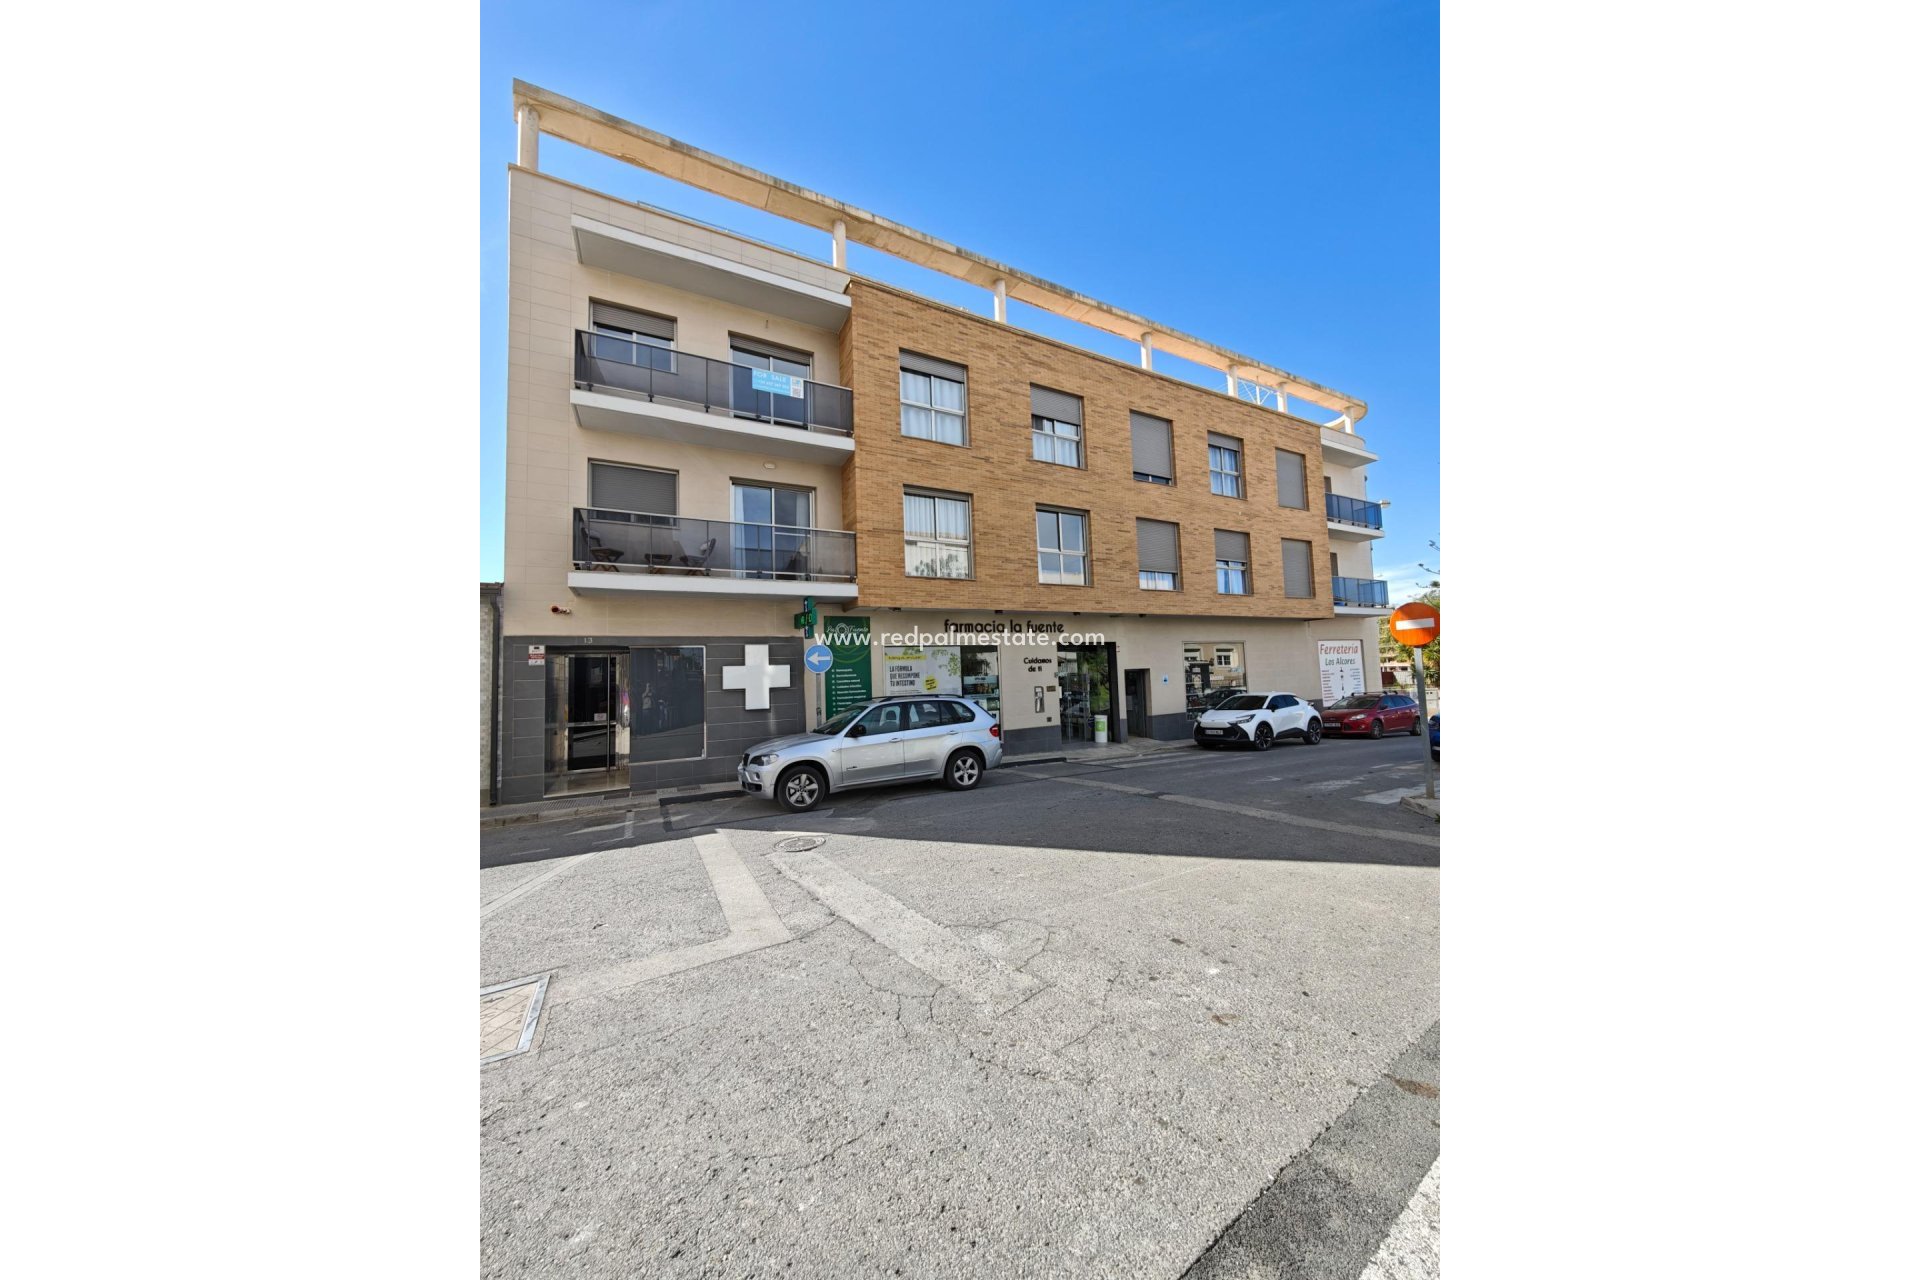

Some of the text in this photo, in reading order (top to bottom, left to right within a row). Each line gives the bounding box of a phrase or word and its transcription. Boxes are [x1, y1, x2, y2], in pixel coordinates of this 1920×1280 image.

[944, 619, 1064, 633] farmacia la fuente
[1320, 643, 1358, 655] Ferretería
[1023, 657, 1052, 665] Cuidamos
[1325, 657, 1355, 666] Los Alcores
